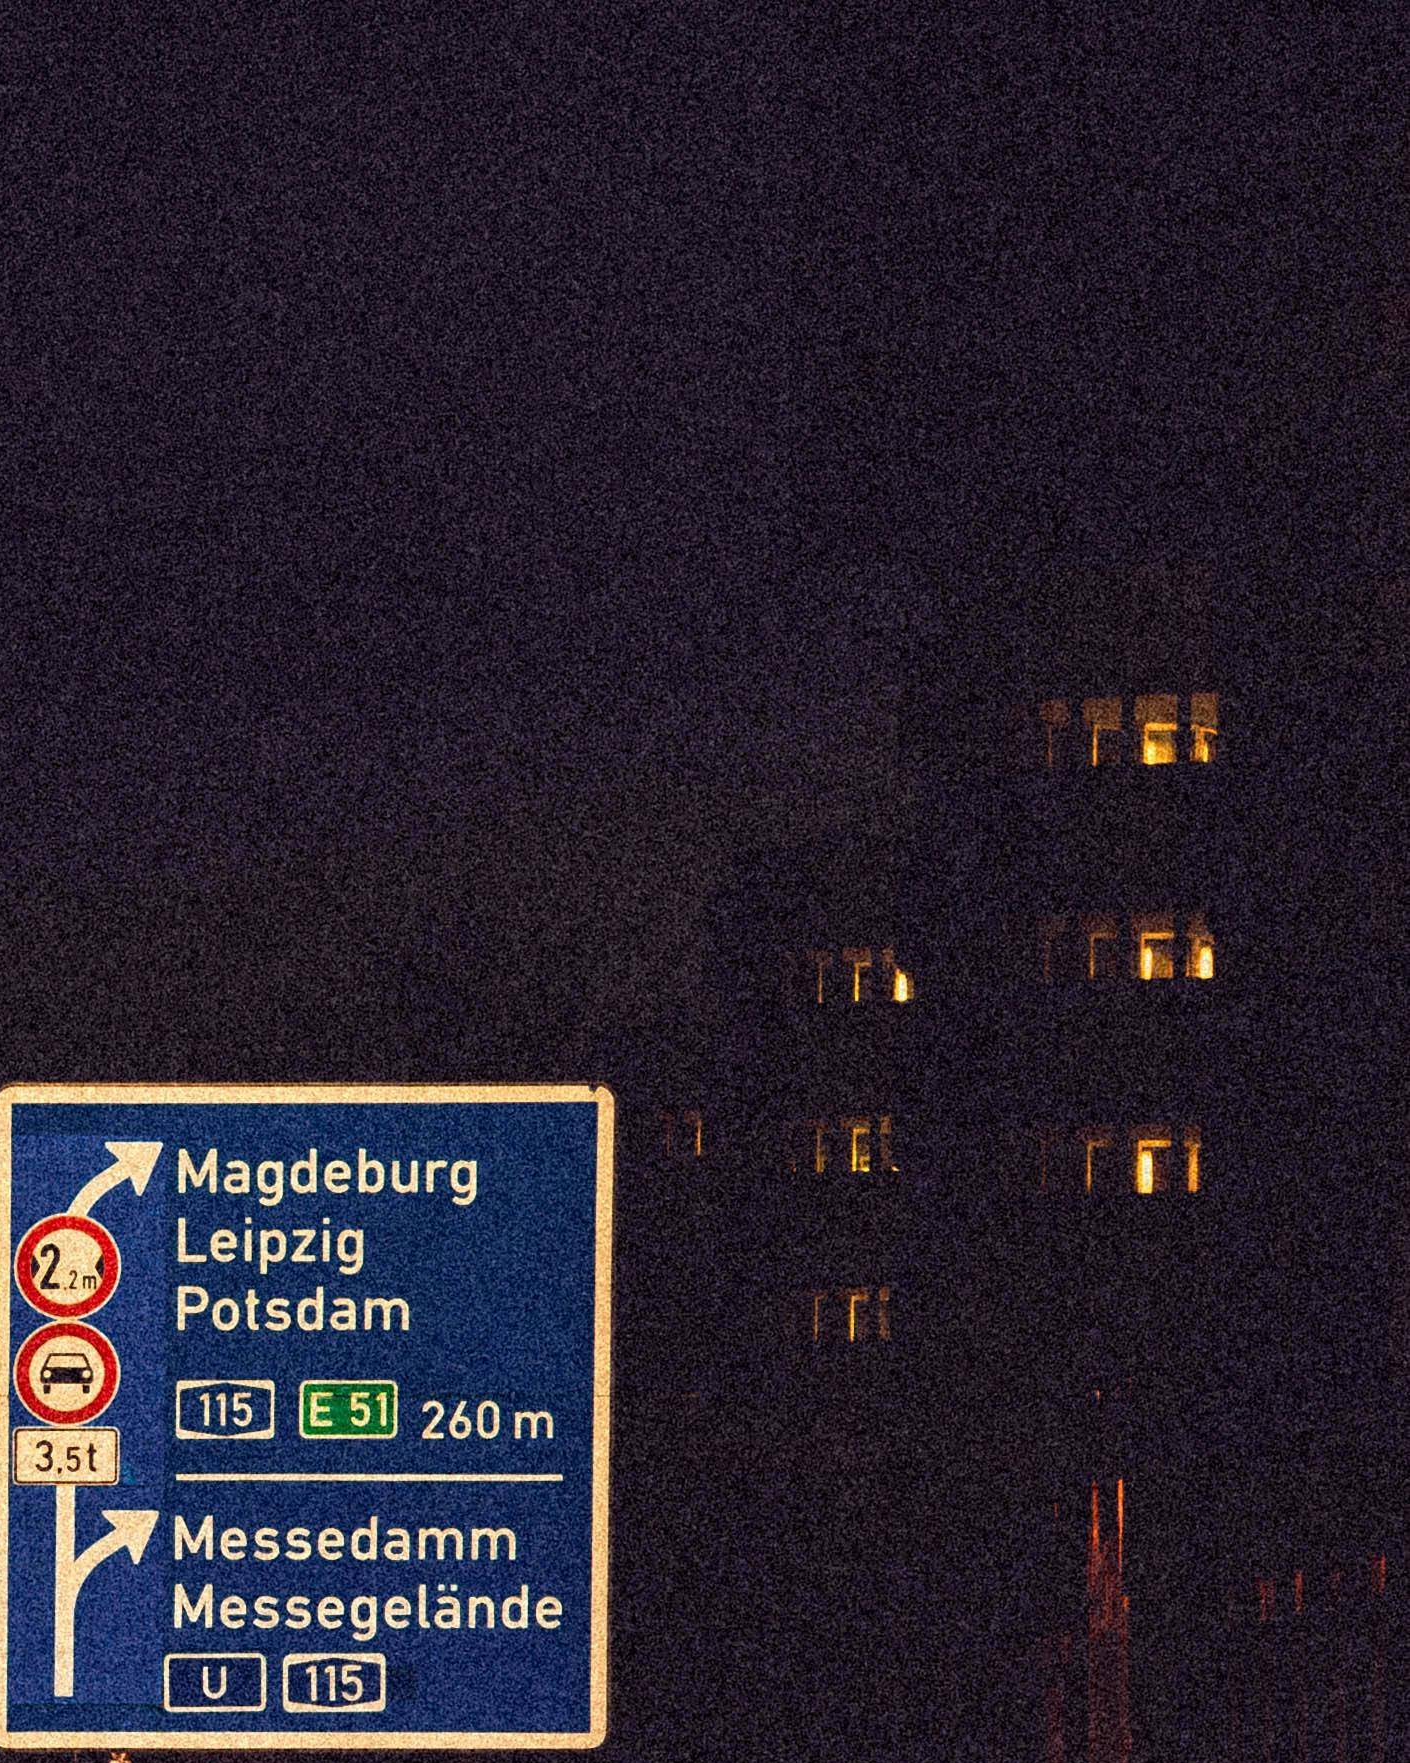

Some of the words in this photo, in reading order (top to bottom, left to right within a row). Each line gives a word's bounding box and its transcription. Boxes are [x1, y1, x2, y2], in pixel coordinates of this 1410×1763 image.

[177, 1148, 478, 1206] Magdeburg
[177, 1217, 364, 1275] Leipzig
[176, 1285, 410, 1332] Potsdam
[200, 1392, 253, 1427] 115
[309, 1391, 332, 1427] E
[350, 1391, 388, 1427] 51
[422, 1400, 500, 1440] 260
[514, 1410, 554, 1439] m
[174, 1515, 517, 1561] Messedamm
[173, 1583, 563, 1641] Messegelände
[201, 1666, 227, 1700] U
[305, 1664, 364, 1702] 115
